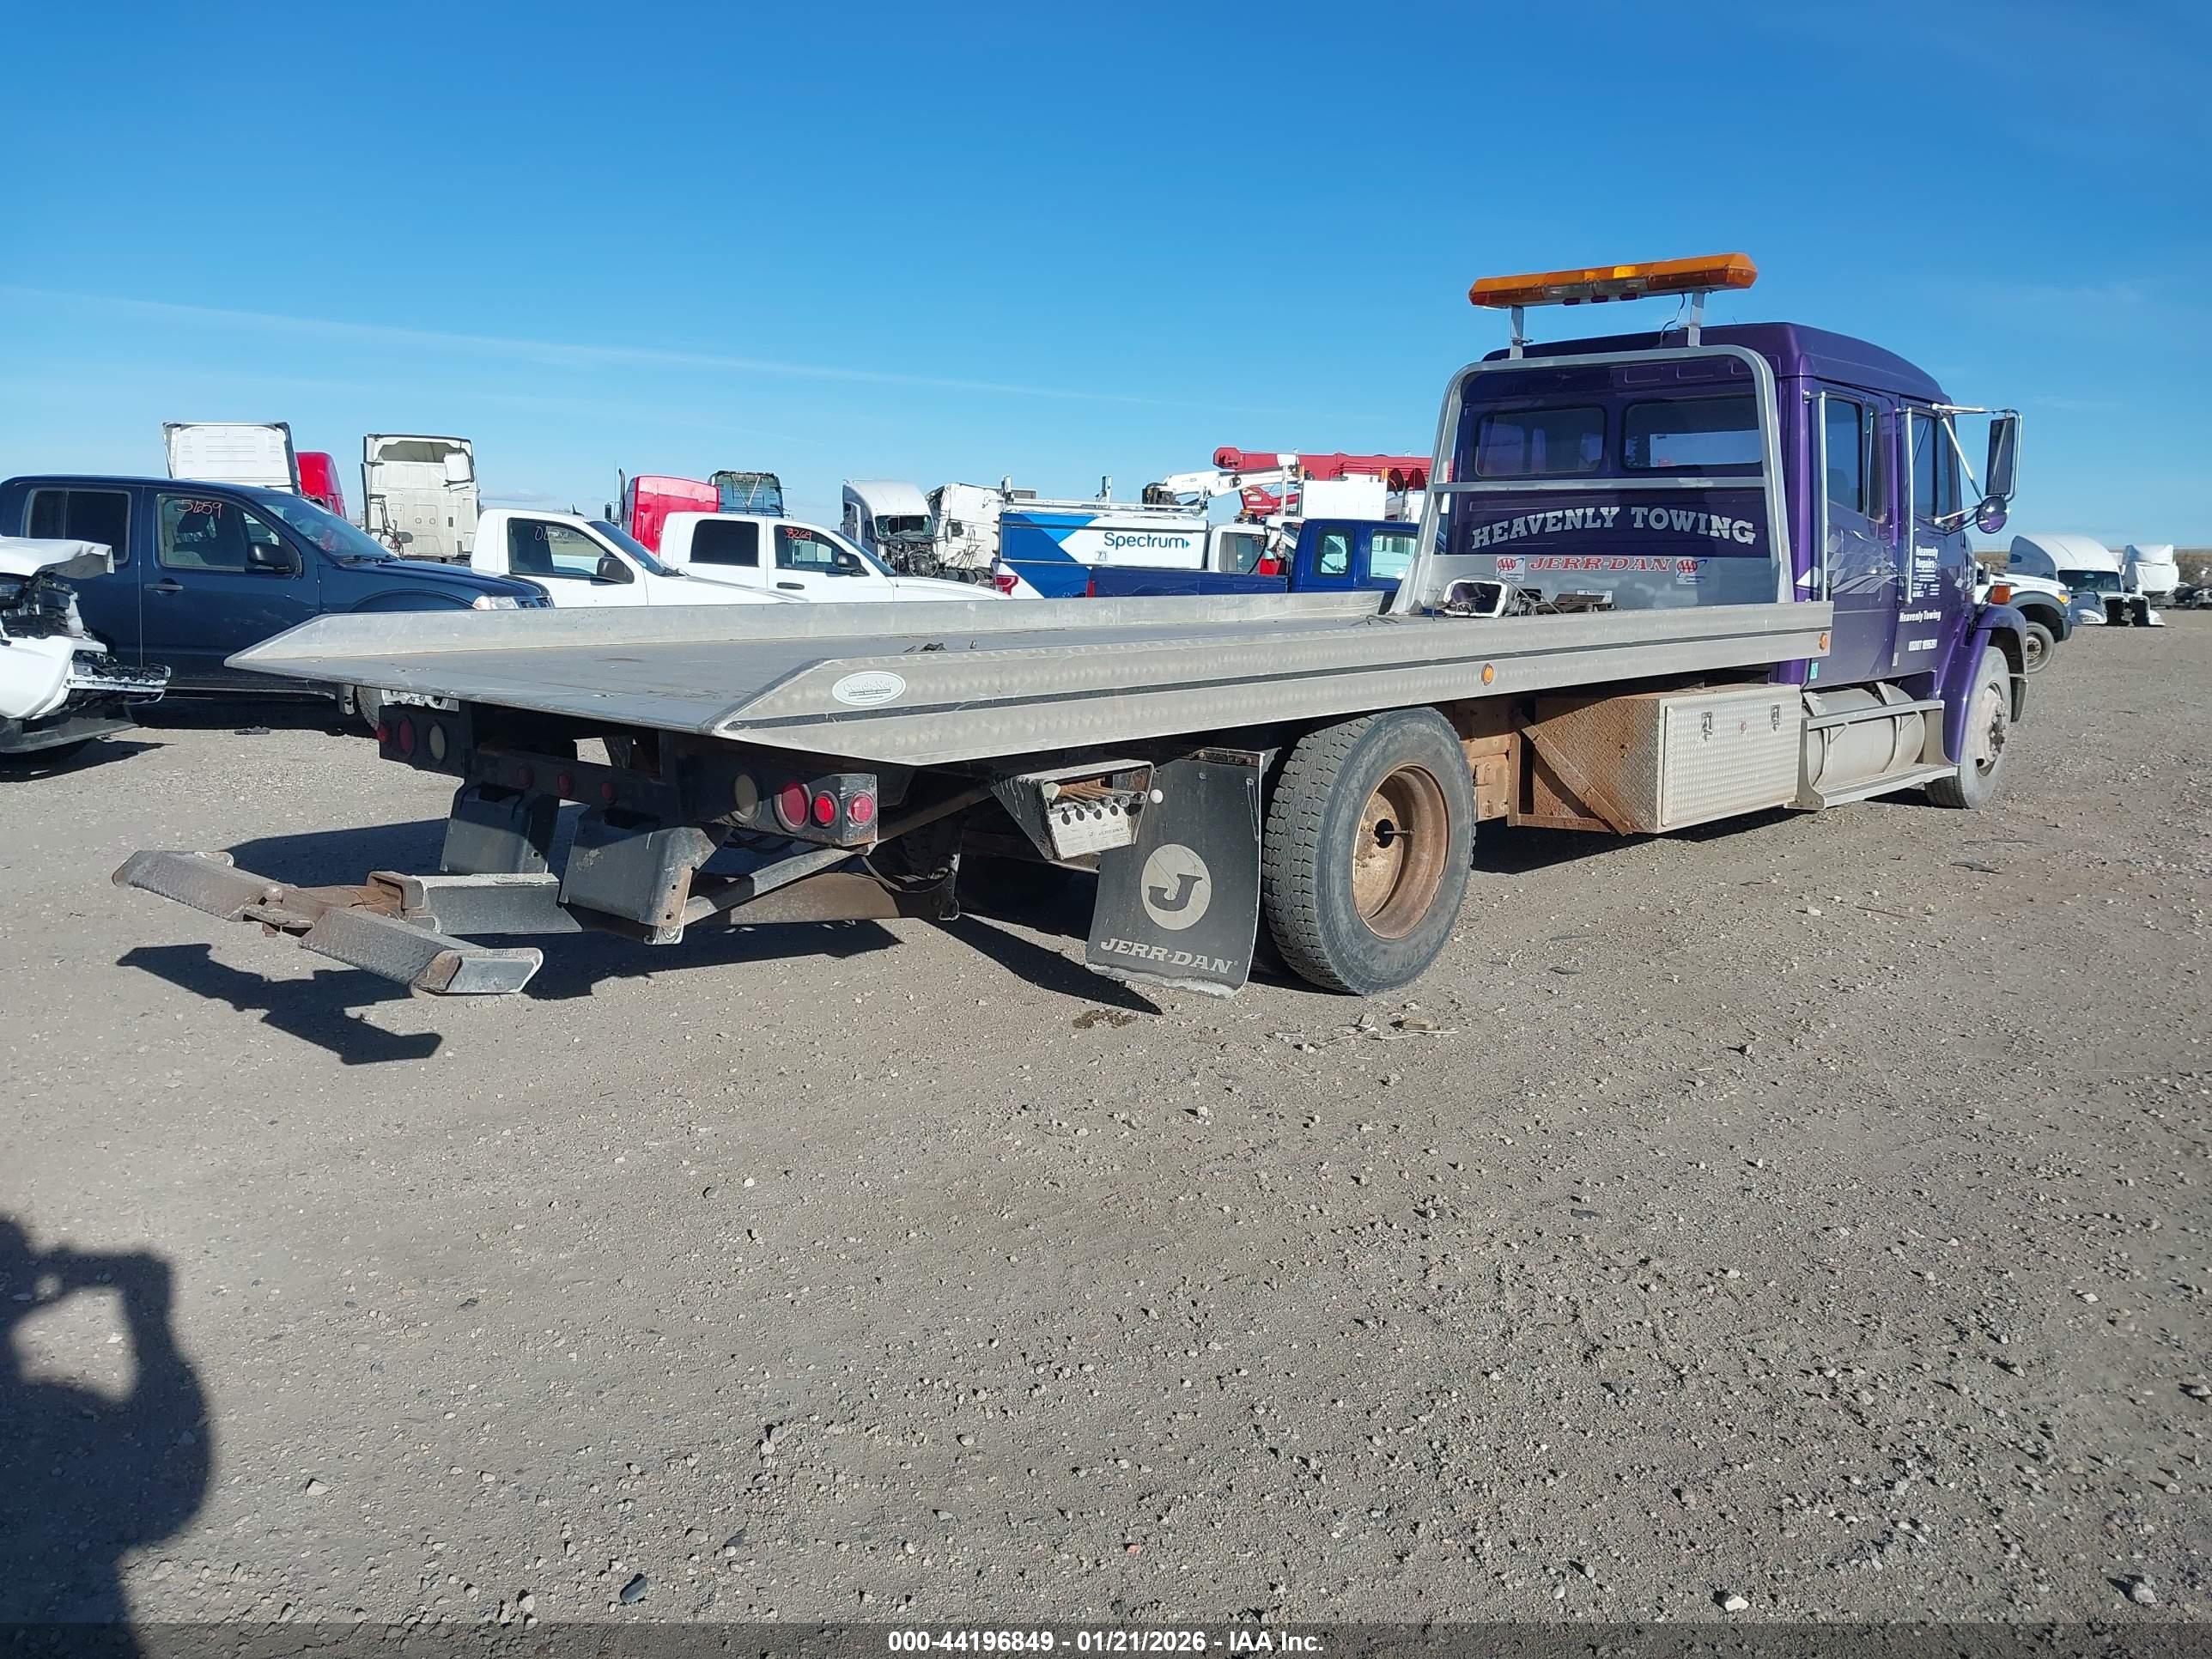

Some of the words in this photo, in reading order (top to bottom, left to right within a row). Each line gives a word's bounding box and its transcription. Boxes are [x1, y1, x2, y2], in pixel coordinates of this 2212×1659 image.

[1471, 507, 1620, 549] HEAVENLY
[1631, 507, 1756, 544] TOWING
[1103, 532, 1186, 550] Spectrum
[1916, 545, 1939, 559] Heavenly
[1528, 556, 1671, 571] JERR-DAN
[1899, 611, 1923, 623] Heavenly
[1923, 609, 1942, 622] Towing
[1148, 872, 1203, 912] J
[1100, 937, 1234, 975] JERR-DAN
